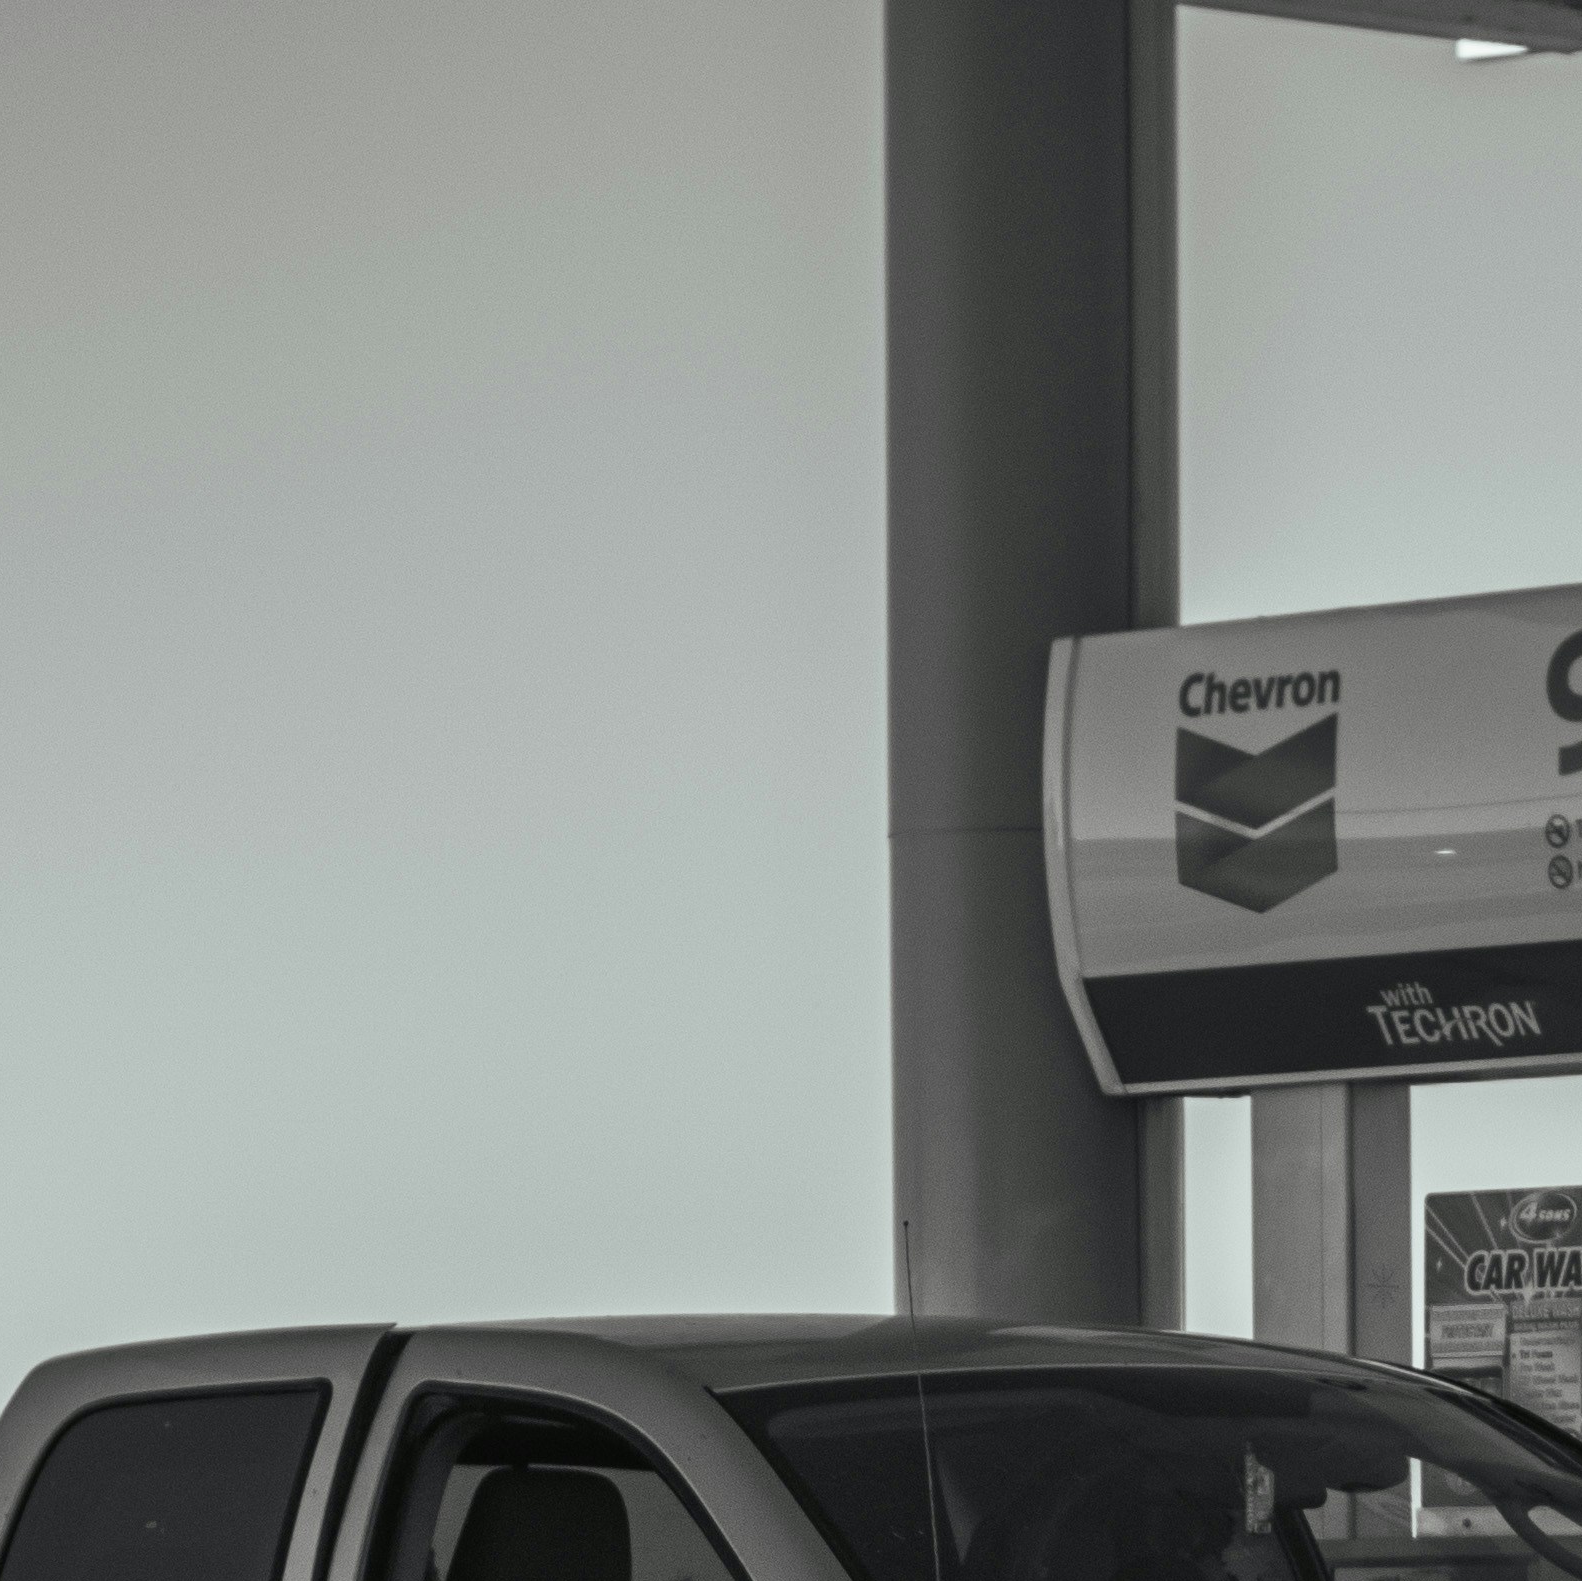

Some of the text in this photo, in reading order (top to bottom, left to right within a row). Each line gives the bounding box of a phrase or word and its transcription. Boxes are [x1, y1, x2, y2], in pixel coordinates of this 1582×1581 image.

[1179, 668, 1340, 717] Chevron
[1380, 981, 1433, 1008] with
[1365, 1000, 1543, 1047] TECHRON
[1465, 1250, 1528, 1294] CAR
